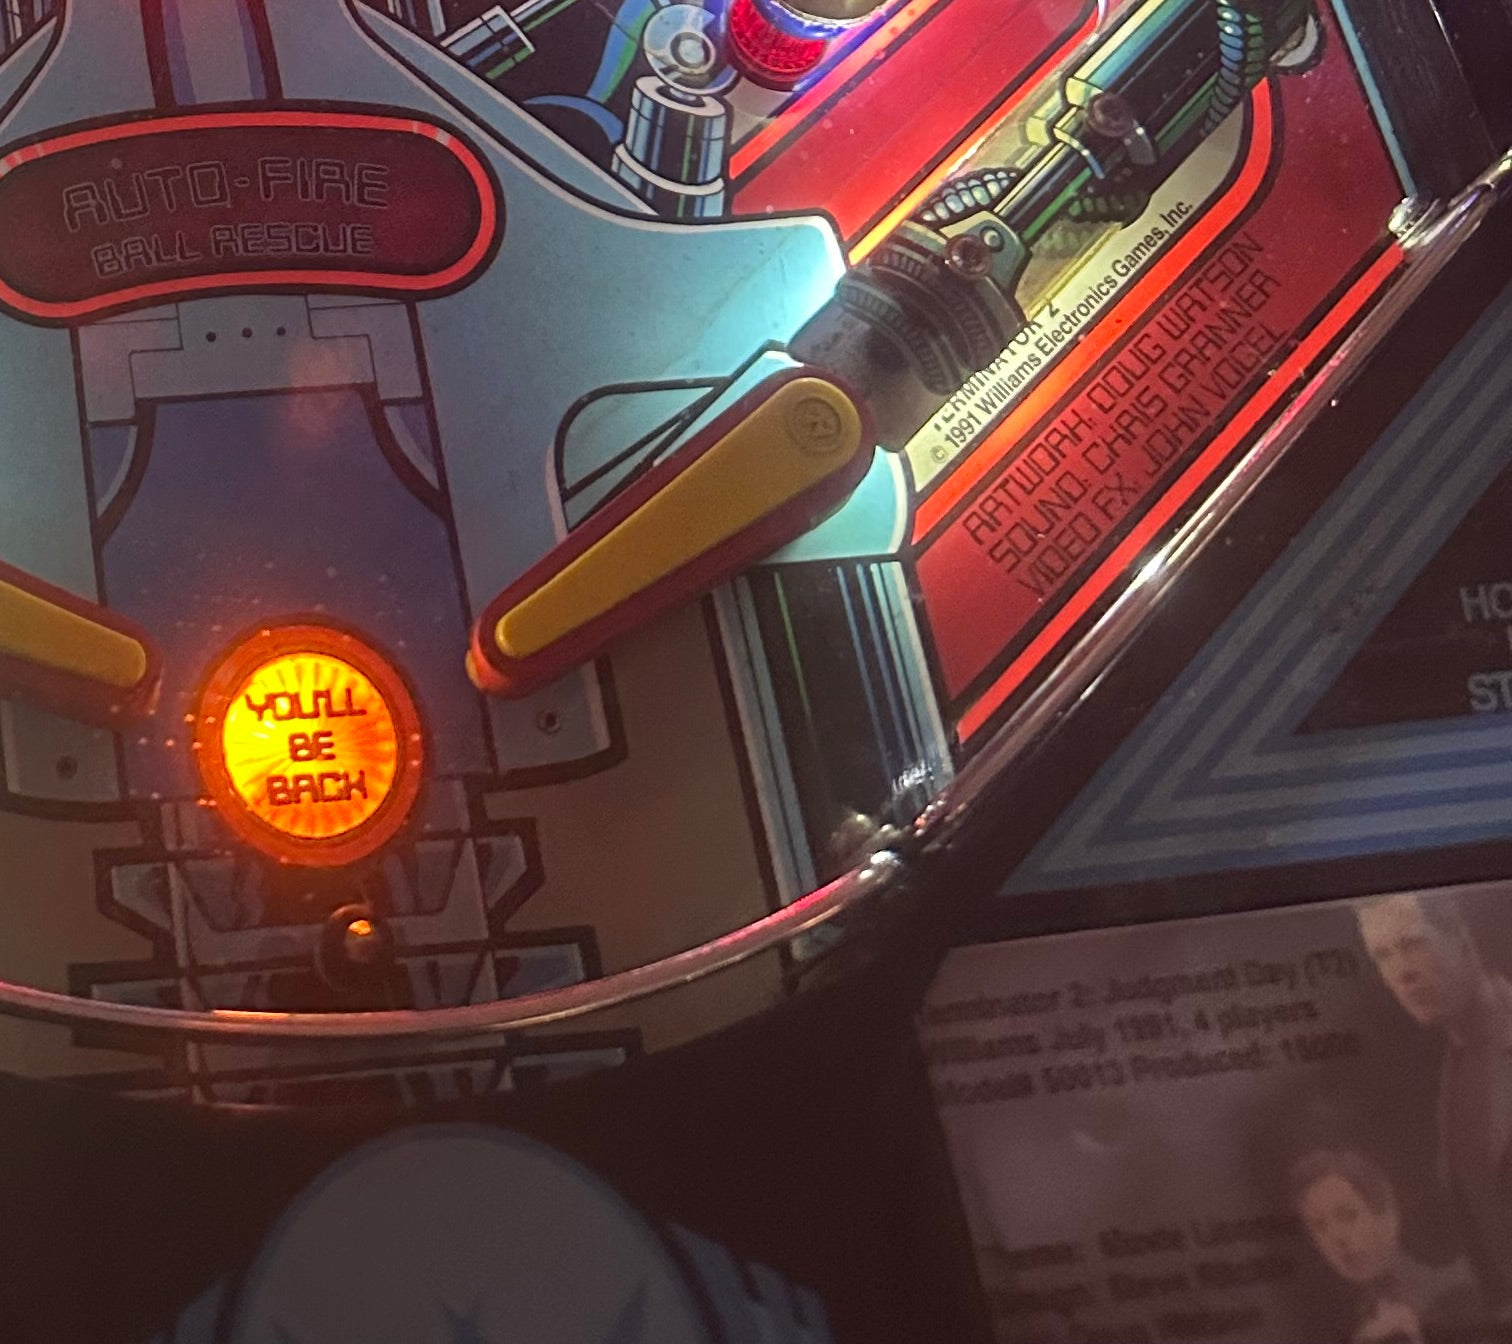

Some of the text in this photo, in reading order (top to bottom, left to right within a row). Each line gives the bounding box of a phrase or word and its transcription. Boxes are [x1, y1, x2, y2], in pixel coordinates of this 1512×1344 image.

[61, 156, 391, 234] AUTO-FIRE
[91, 221, 377, 281] BALL RESCUE
[944, 412, 983, 450] 1991
[975, 351, 1043, 423] Williams
[1034, 273, 1119, 357] Electronics
[1110, 226, 1172, 278] Games,
[1161, 200, 1194, 235] Inc.
[1047, 299, 1061, 318] 2
[1086, 331, 1168, 422] DOUG
[1162, 231, 1267, 347] WATSON
[1082, 384, 1168, 477] CHRIS
[1157, 268, 1282, 397] GRANNER
[1017, 518, 1101, 598] VIDEO
[1142, 403, 1211, 478] JOHN
[1197, 322, 1291, 401] VOGEL
[288, 730, 337, 762] BE
[266, 769, 369, 807] BACK
